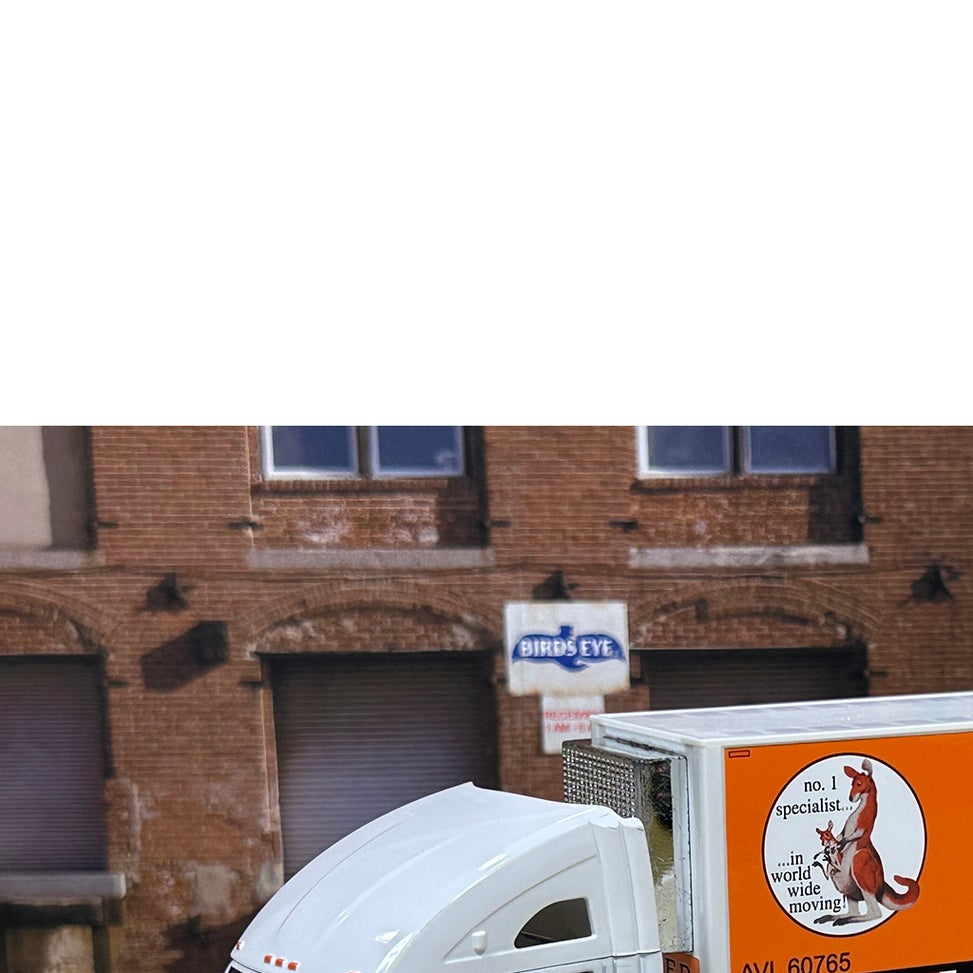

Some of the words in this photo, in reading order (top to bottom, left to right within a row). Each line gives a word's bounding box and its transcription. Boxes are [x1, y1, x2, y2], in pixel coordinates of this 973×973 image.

[519, 636, 577, 658] BIRDS
[580, 637, 613, 658] EYE
[804, 780, 825, 793] no.
[831, 776, 837, 790] 1
[771, 866, 812, 883] world
[787, 882, 821, 898] wide
[789, 895, 847, 914] moving!
